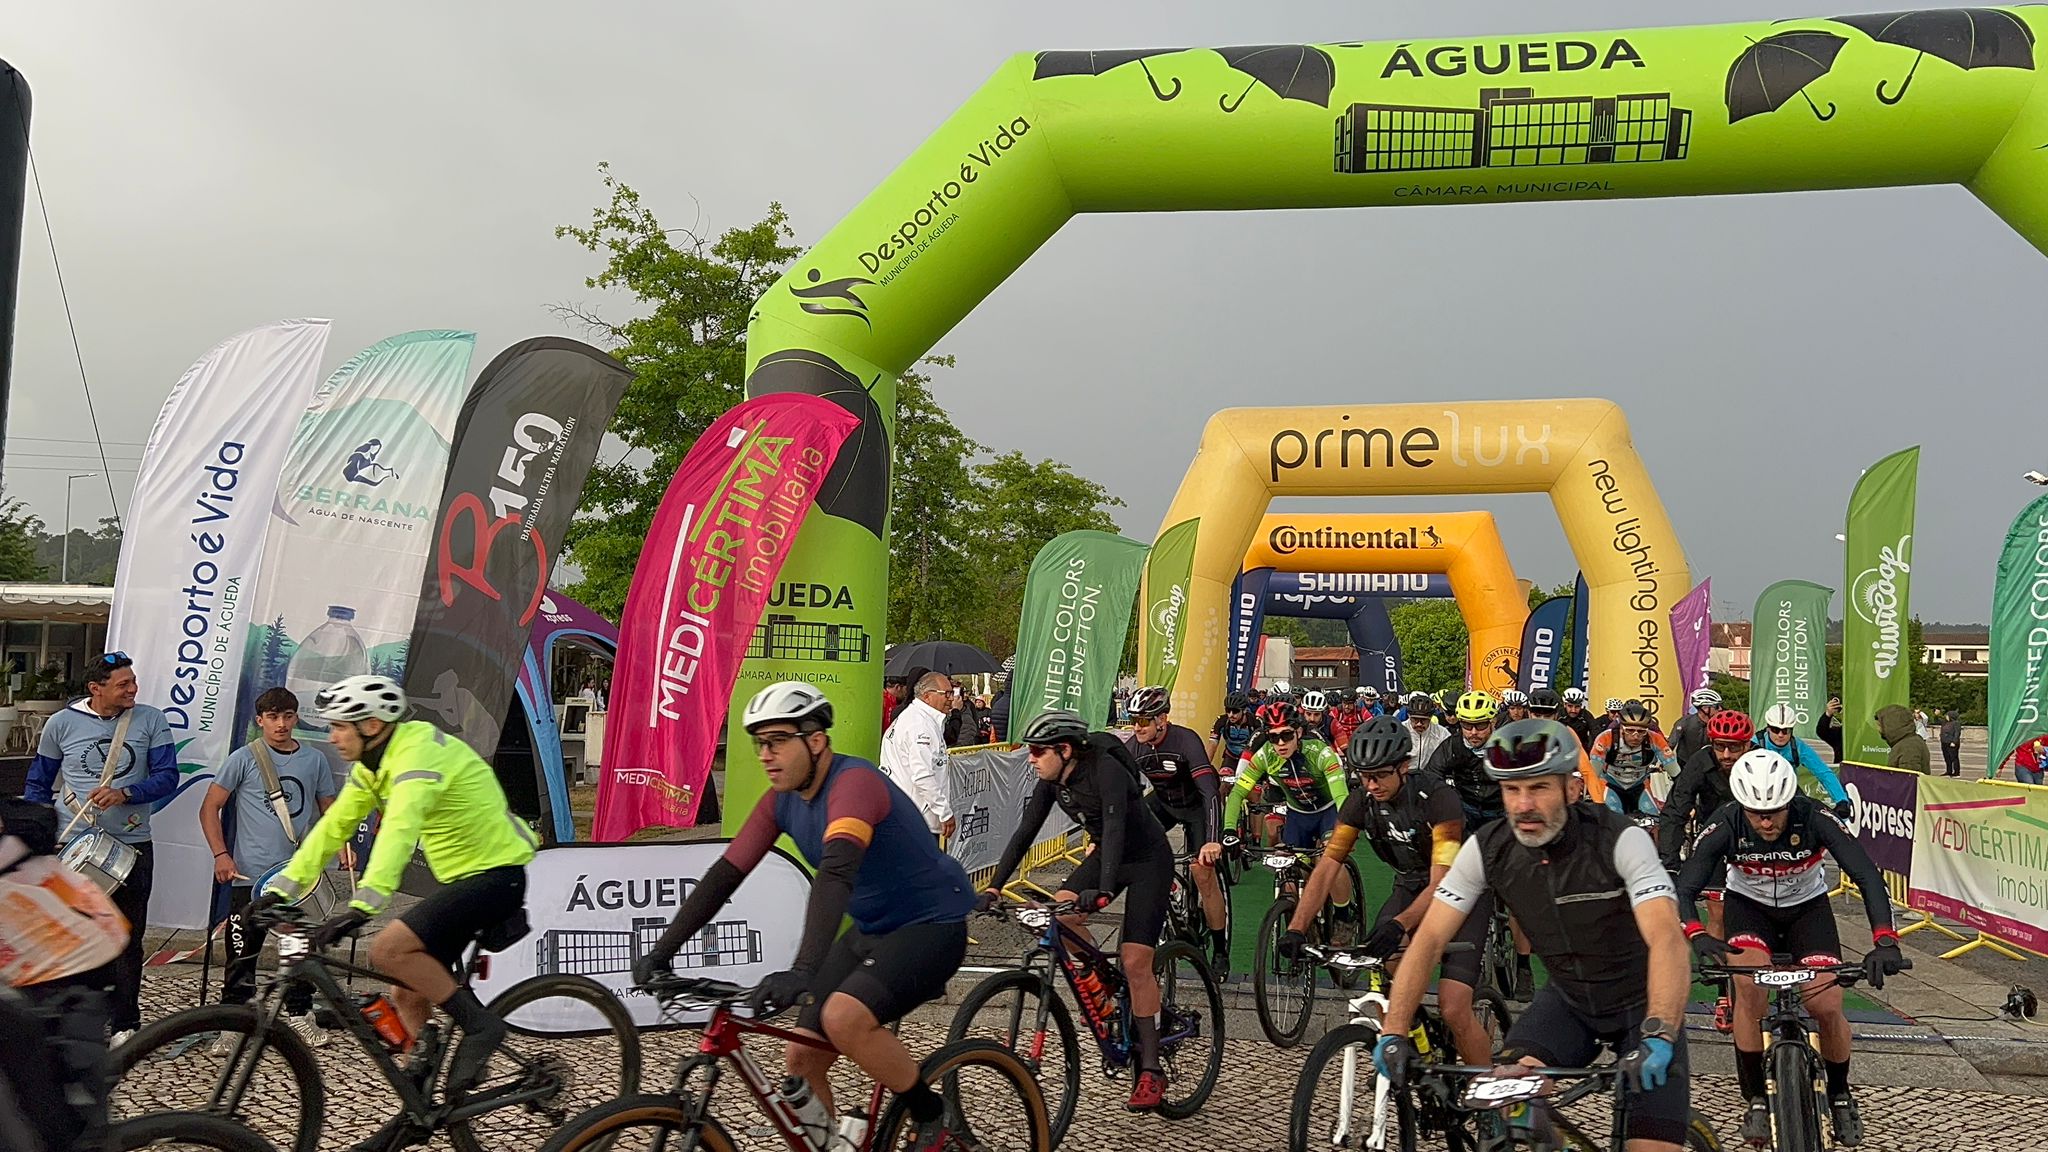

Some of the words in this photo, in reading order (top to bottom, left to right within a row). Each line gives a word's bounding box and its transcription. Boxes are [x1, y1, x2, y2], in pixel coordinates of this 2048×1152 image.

[1380, 38, 1646, 79] ÁGUEDA
[967, 116, 1031, 167] Vida
[960, 162, 978, 183] é
[1394, 184, 1488, 198] CÂMARA
[1496, 180, 1615, 194] MUNICIPAL
[857, 181, 961, 275] Desporto
[880, 250, 919, 288] MUNICÍPIO
[918, 240, 930, 253] DE
[928, 213, 960, 243] ÁGUEDA
[191, 441, 246, 524] Vida
[520, 498, 545, 542] BAIRRADA
[538, 467, 556, 496] ULTRA
[551, 416, 577, 466] MARATHON
[298, 484, 430, 521] SERRANA
[308, 506, 337, 518] ÁGUA
[341, 513, 354, 521] DE
[358, 516, 413, 531] NASCENTE
[735, 446, 823, 594] imobiliária
[190, 532, 225, 554] é
[1269, 525, 1418, 554] Continental
[1588, 460, 1627, 514] new
[1613, 517, 1660, 611] lighting
[658, 434, 794, 720] MEDICÉRTIMA
[766, 582, 855, 610] UEDA
[1298, 573, 1428, 592] SHIMANO
[217, 576, 241, 632] ÁGUEDA
[1053, 557, 1086, 643] COLORS
[163, 561, 219, 730] Desporto
[214, 635, 229, 653] DE
[1776, 600, 1792, 662] COLORS
[199, 657, 225, 733] MUNICÍPIO
[776, 671, 841, 683] MUNICIPAL
[1042, 648, 1067, 711] NITED
[1776, 667, 1790, 707] NITED
[1795, 703, 1809, 725] OF
[566, 874, 732, 912] ÁGUED
[1489, 1083, 1518, 1096] 205
